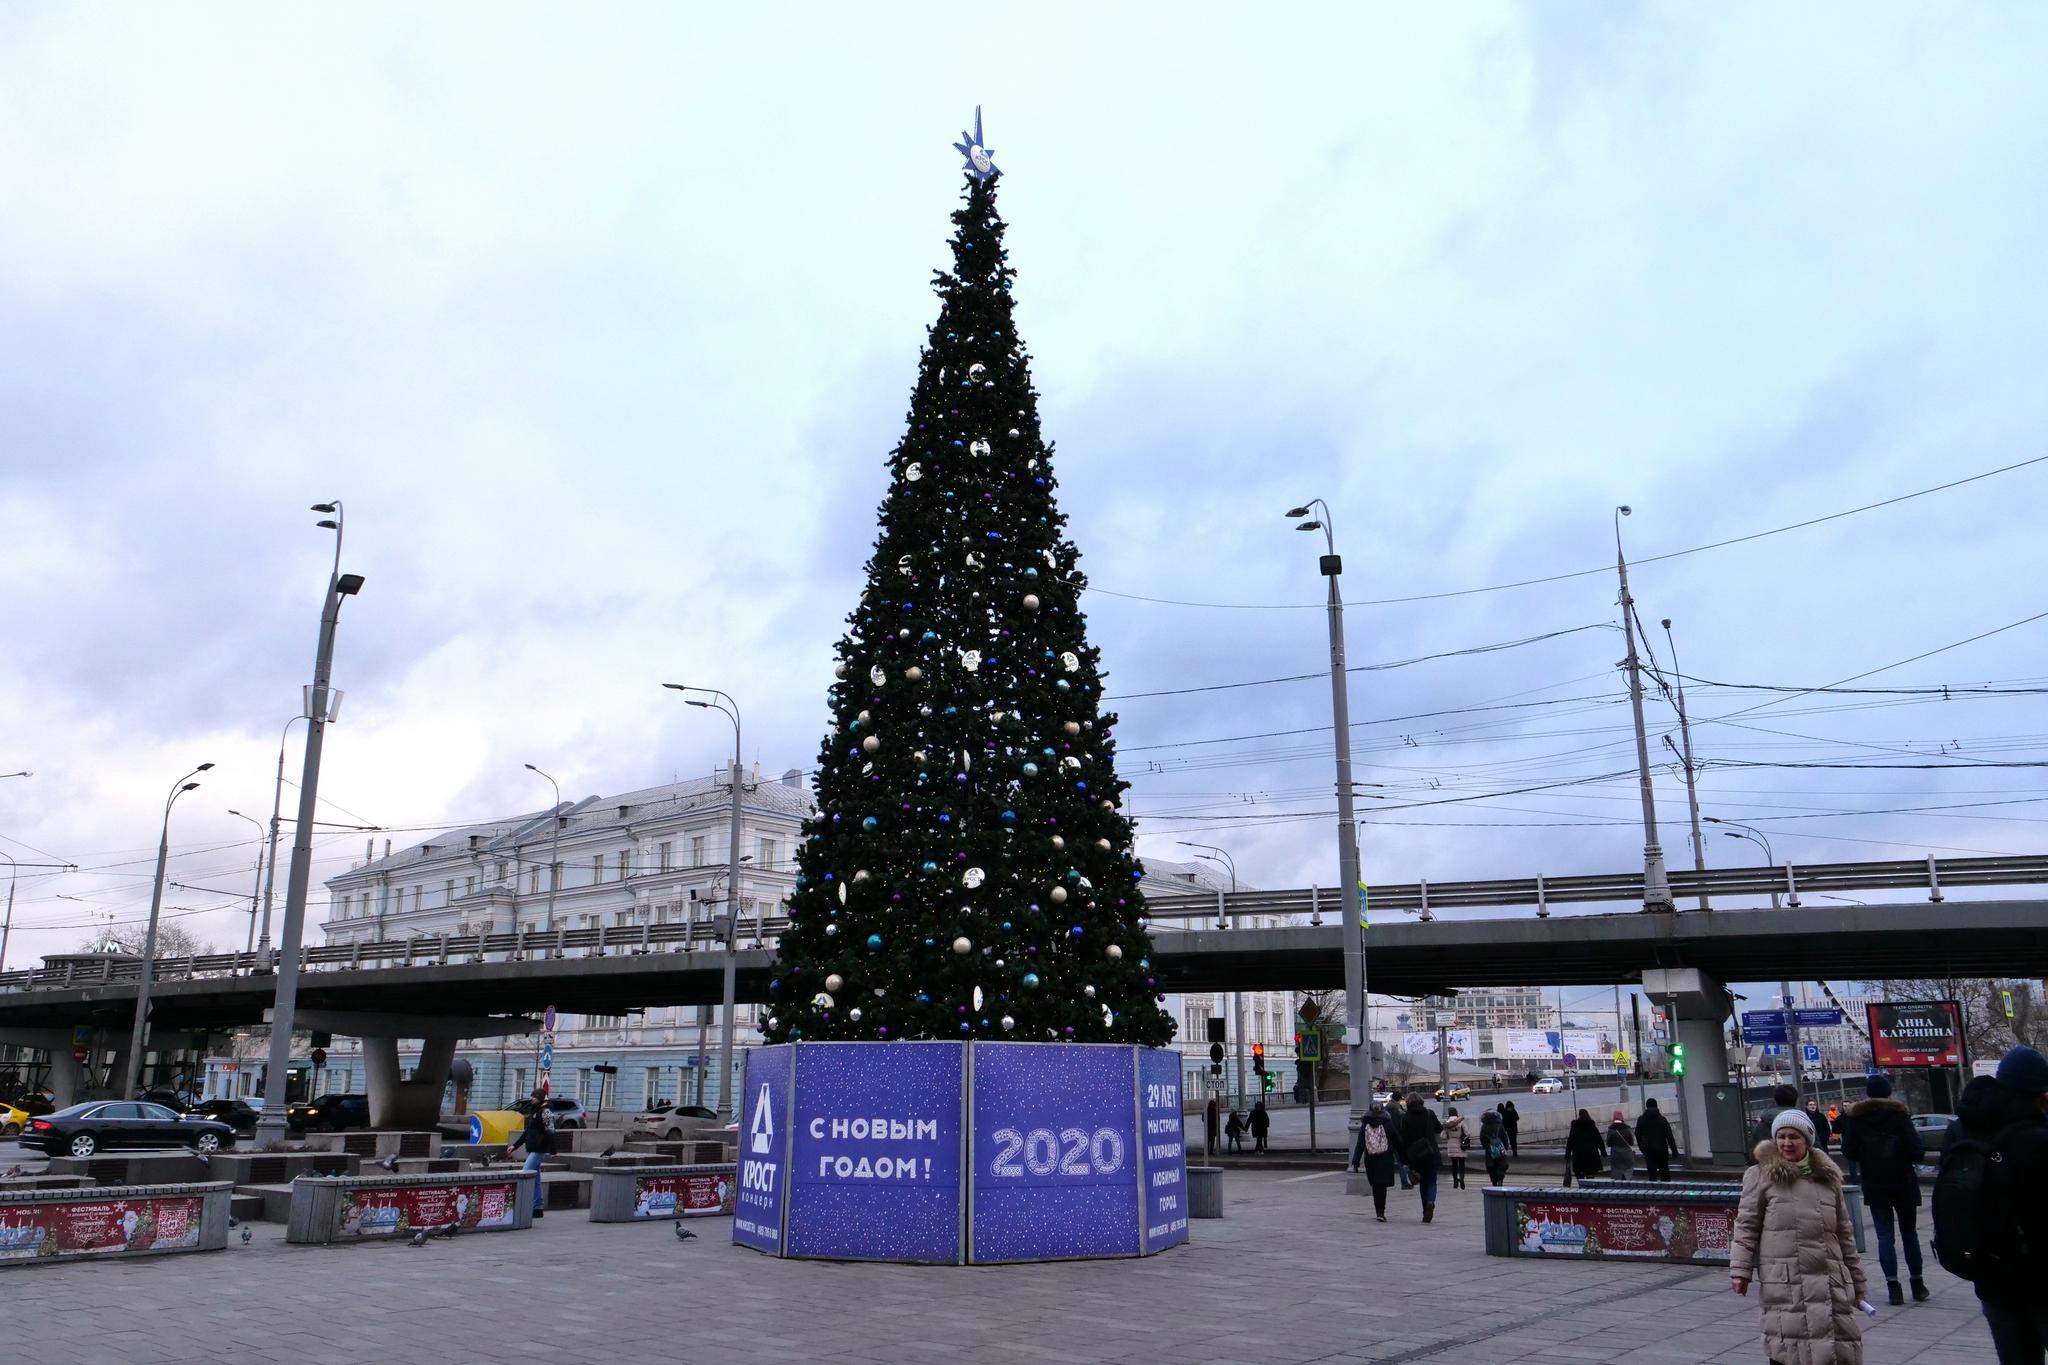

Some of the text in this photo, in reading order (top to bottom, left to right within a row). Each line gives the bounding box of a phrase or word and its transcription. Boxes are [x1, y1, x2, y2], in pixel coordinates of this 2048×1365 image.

[1896, 1018, 1934, 1027] АННА
[1879, 1028, 1953, 1038] КАРЕНИНА
[1206, 1080, 1225, 1089] СТОП
[1147, 1084, 1177, 1108] 29 ЛЕТ
[809, 1117, 937, 1140] С НОВЫМ
[1147, 1118, 1180, 1135] МЫ СТРОИМ
[990, 1128, 1125, 1177] 2020
[1147, 1143, 1181, 1160] И УКРАШАЕМ
[743, 1159, 777, 1193] КРОСТ
[1152, 1167, 1180, 1188] ЛЮБИМЫЙ
[71, 1205, 111, 1213] ФЕСТИВАЛЬ
[741, 1191, 774, 1210] концерн
[1159, 1194, 1177, 1212] ГОРОД
